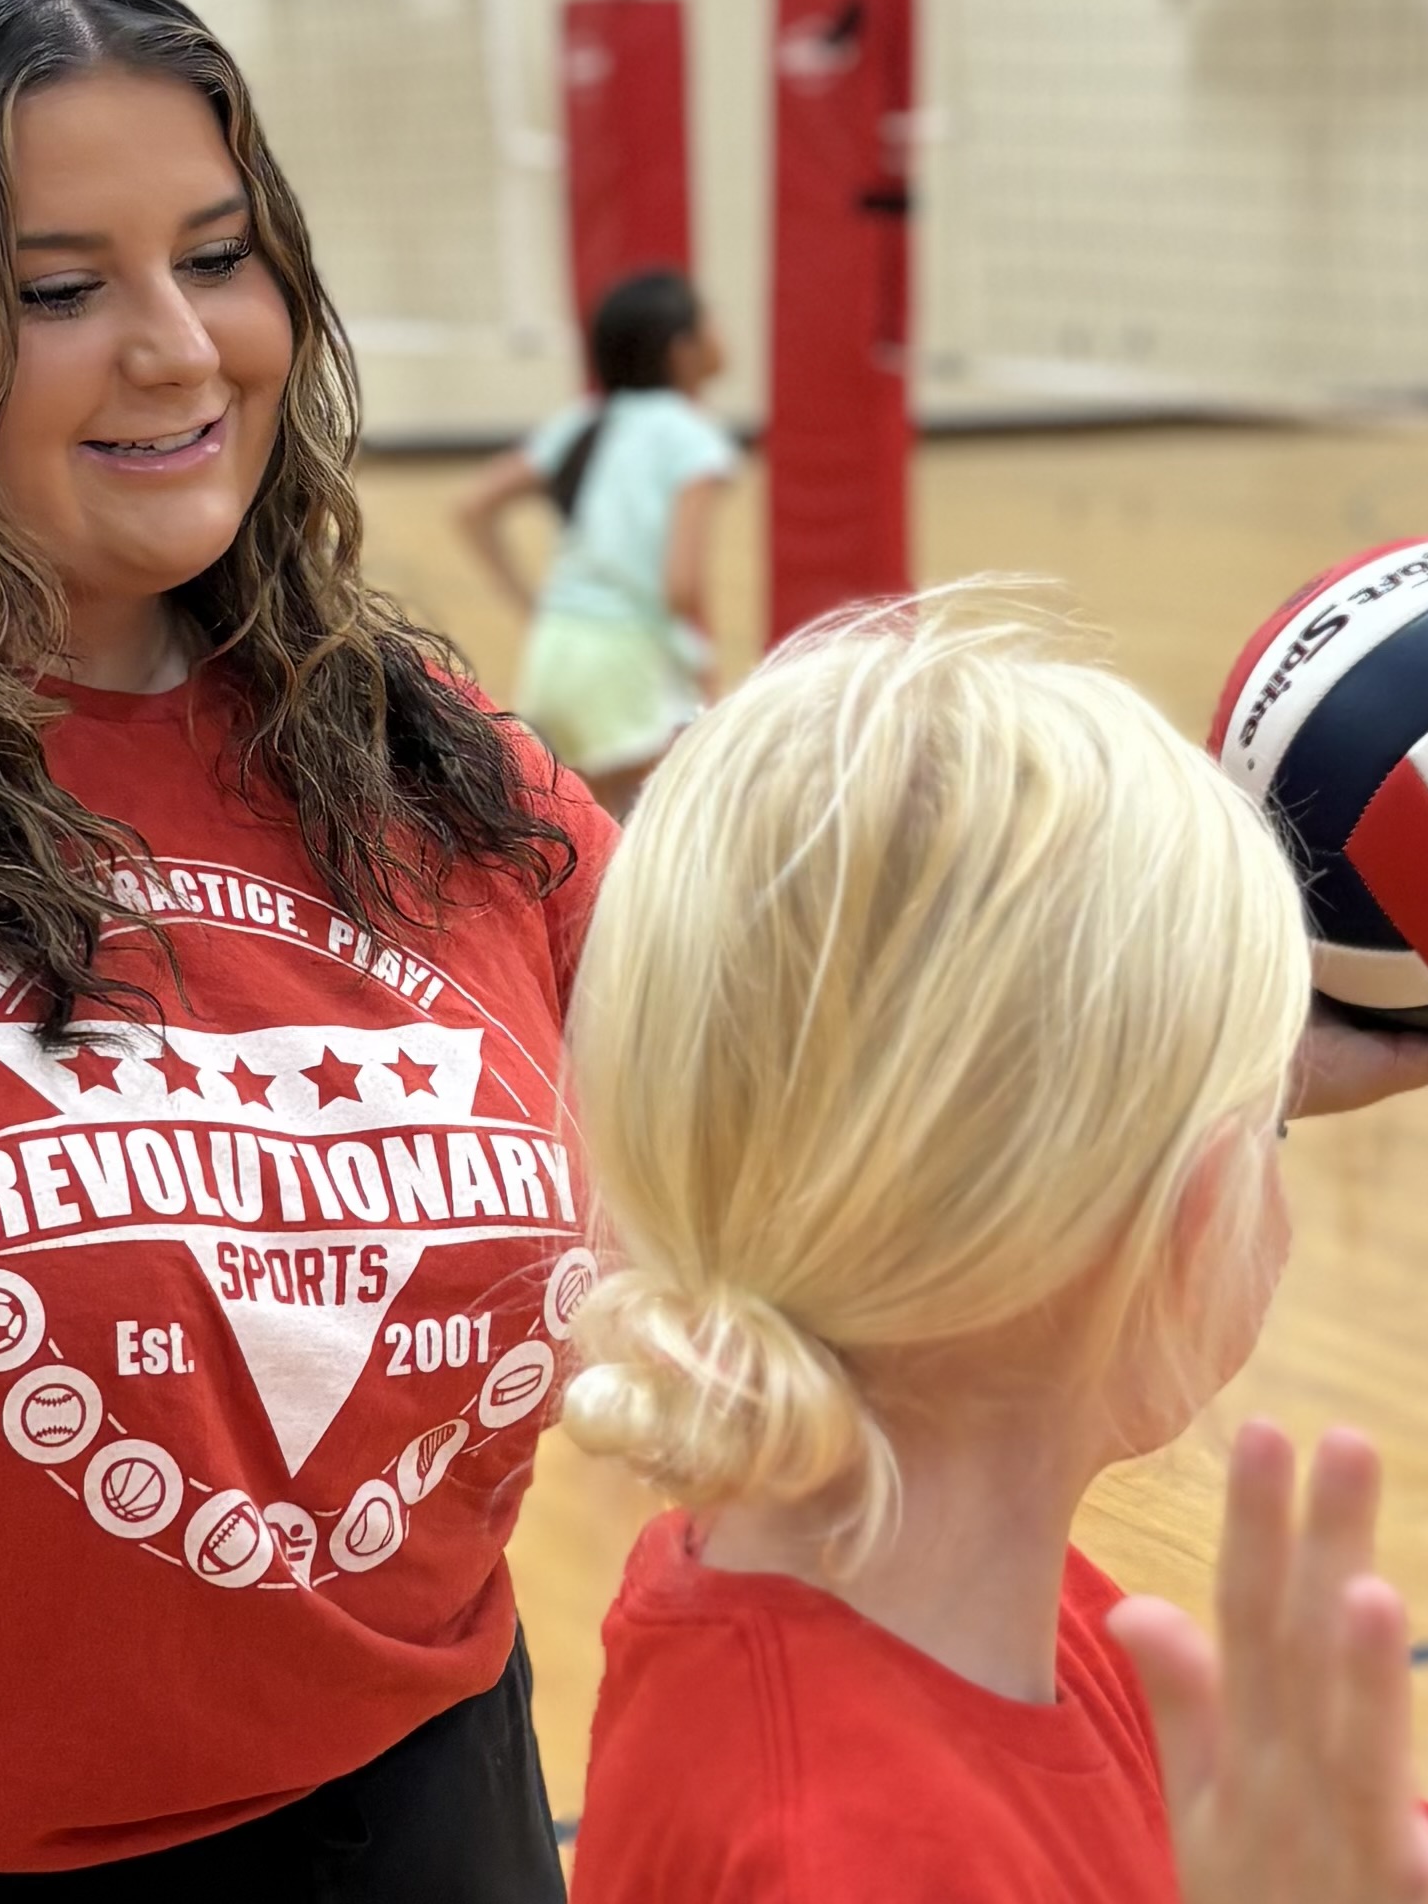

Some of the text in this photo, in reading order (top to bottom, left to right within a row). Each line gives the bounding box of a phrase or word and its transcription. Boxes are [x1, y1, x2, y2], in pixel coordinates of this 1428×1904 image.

[1239, 603, 1350, 750] Spike
[328, 916, 445, 1010] PLAY!
[216, 1241, 388, 1307] SPORTS
[115, 1311, 492, 1377] Est. 2001
